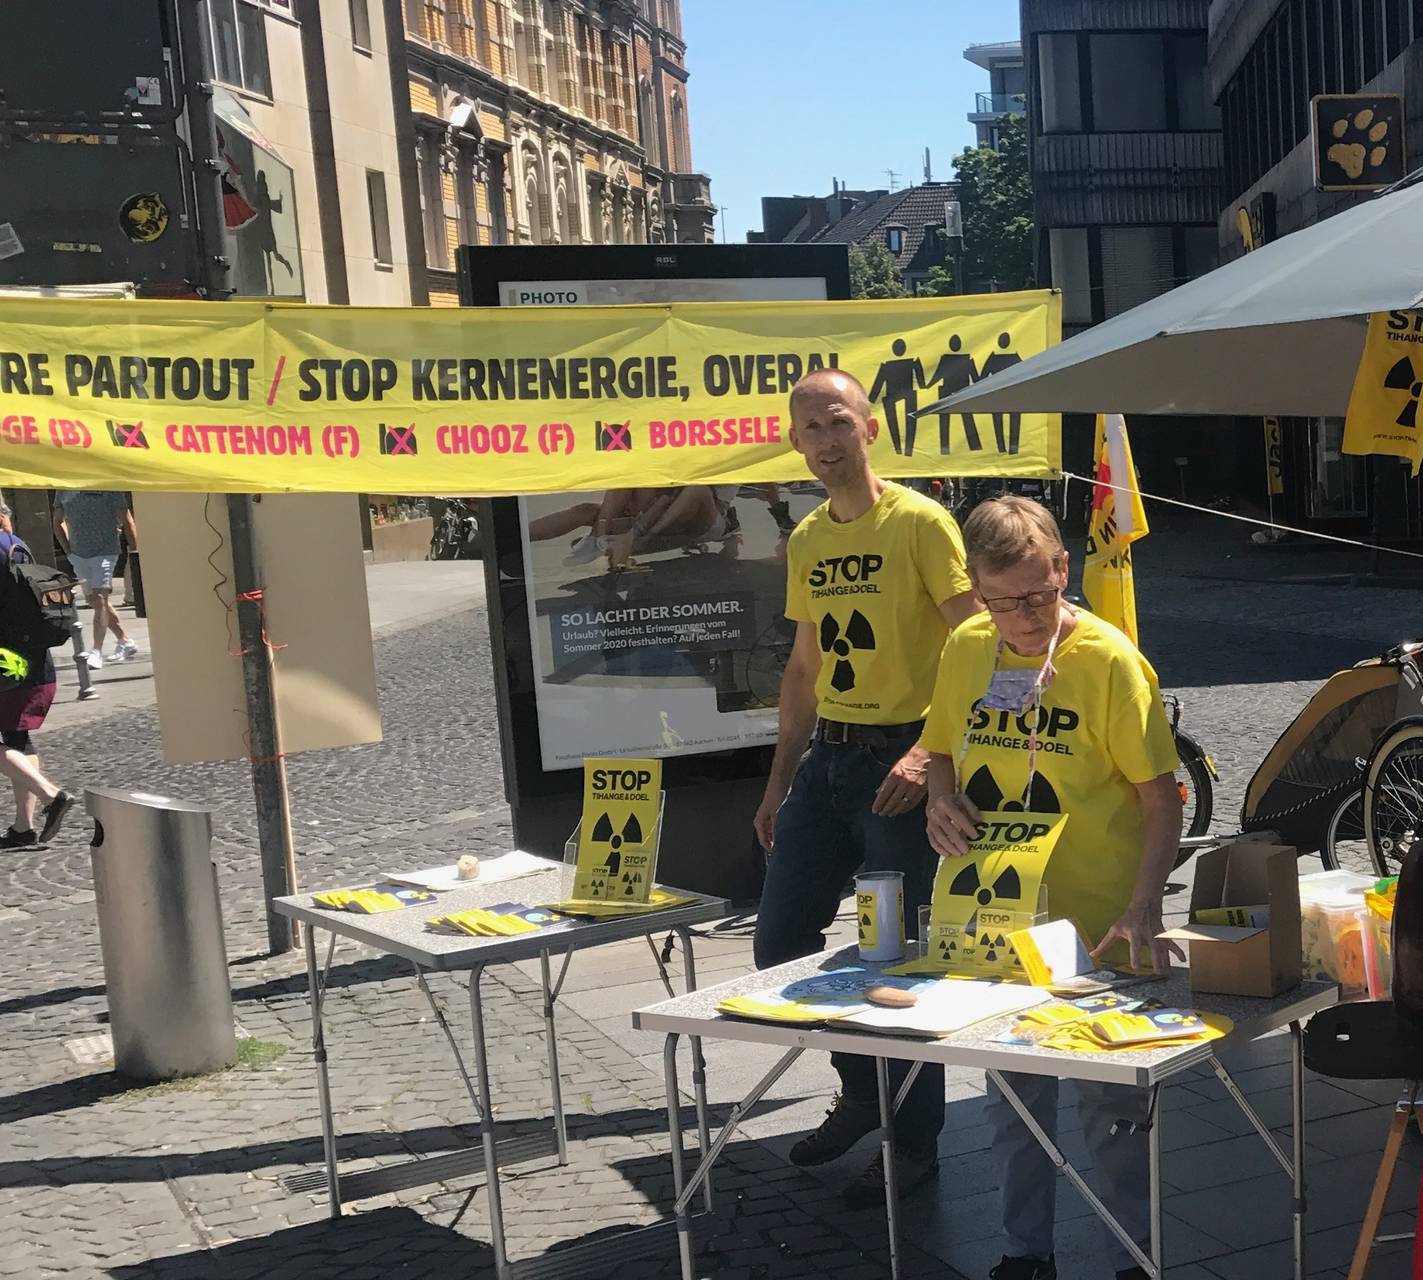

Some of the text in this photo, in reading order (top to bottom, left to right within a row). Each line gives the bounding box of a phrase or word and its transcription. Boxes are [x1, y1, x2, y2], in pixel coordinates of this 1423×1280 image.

[520, 291, 578, 304] PHOTO
[64, 354, 255, 401] PARTOUT
[298, 358, 398, 402] STOP
[411, 355, 690, 402] KERNENERGIE,
[48, 417, 93, 449] (B)
[165, 423, 313, 456] CATTENOM
[321, 424, 360, 458] (F)
[436, 423, 529, 455] CHOOZ
[537, 423, 575, 455] (F)
[648, 415, 782, 449] BORSSELE
[808, 554, 883, 587] STOP
[561, 600, 744, 627] SO LACHT DER SOMMER.
[562, 619, 727, 641] Urlaub? Vielleicht. Erinnerungen vom
[563, 628, 741, 653] Sommer 2020 festhalten? Auf jeden Fall!
[967, 698, 1080, 738] STOP
[592, 769, 651, 791] STOP
[966, 822, 1050, 843] STOP
[624, 855, 648, 864] STOP
[980, 913, 1010, 924] STOP
